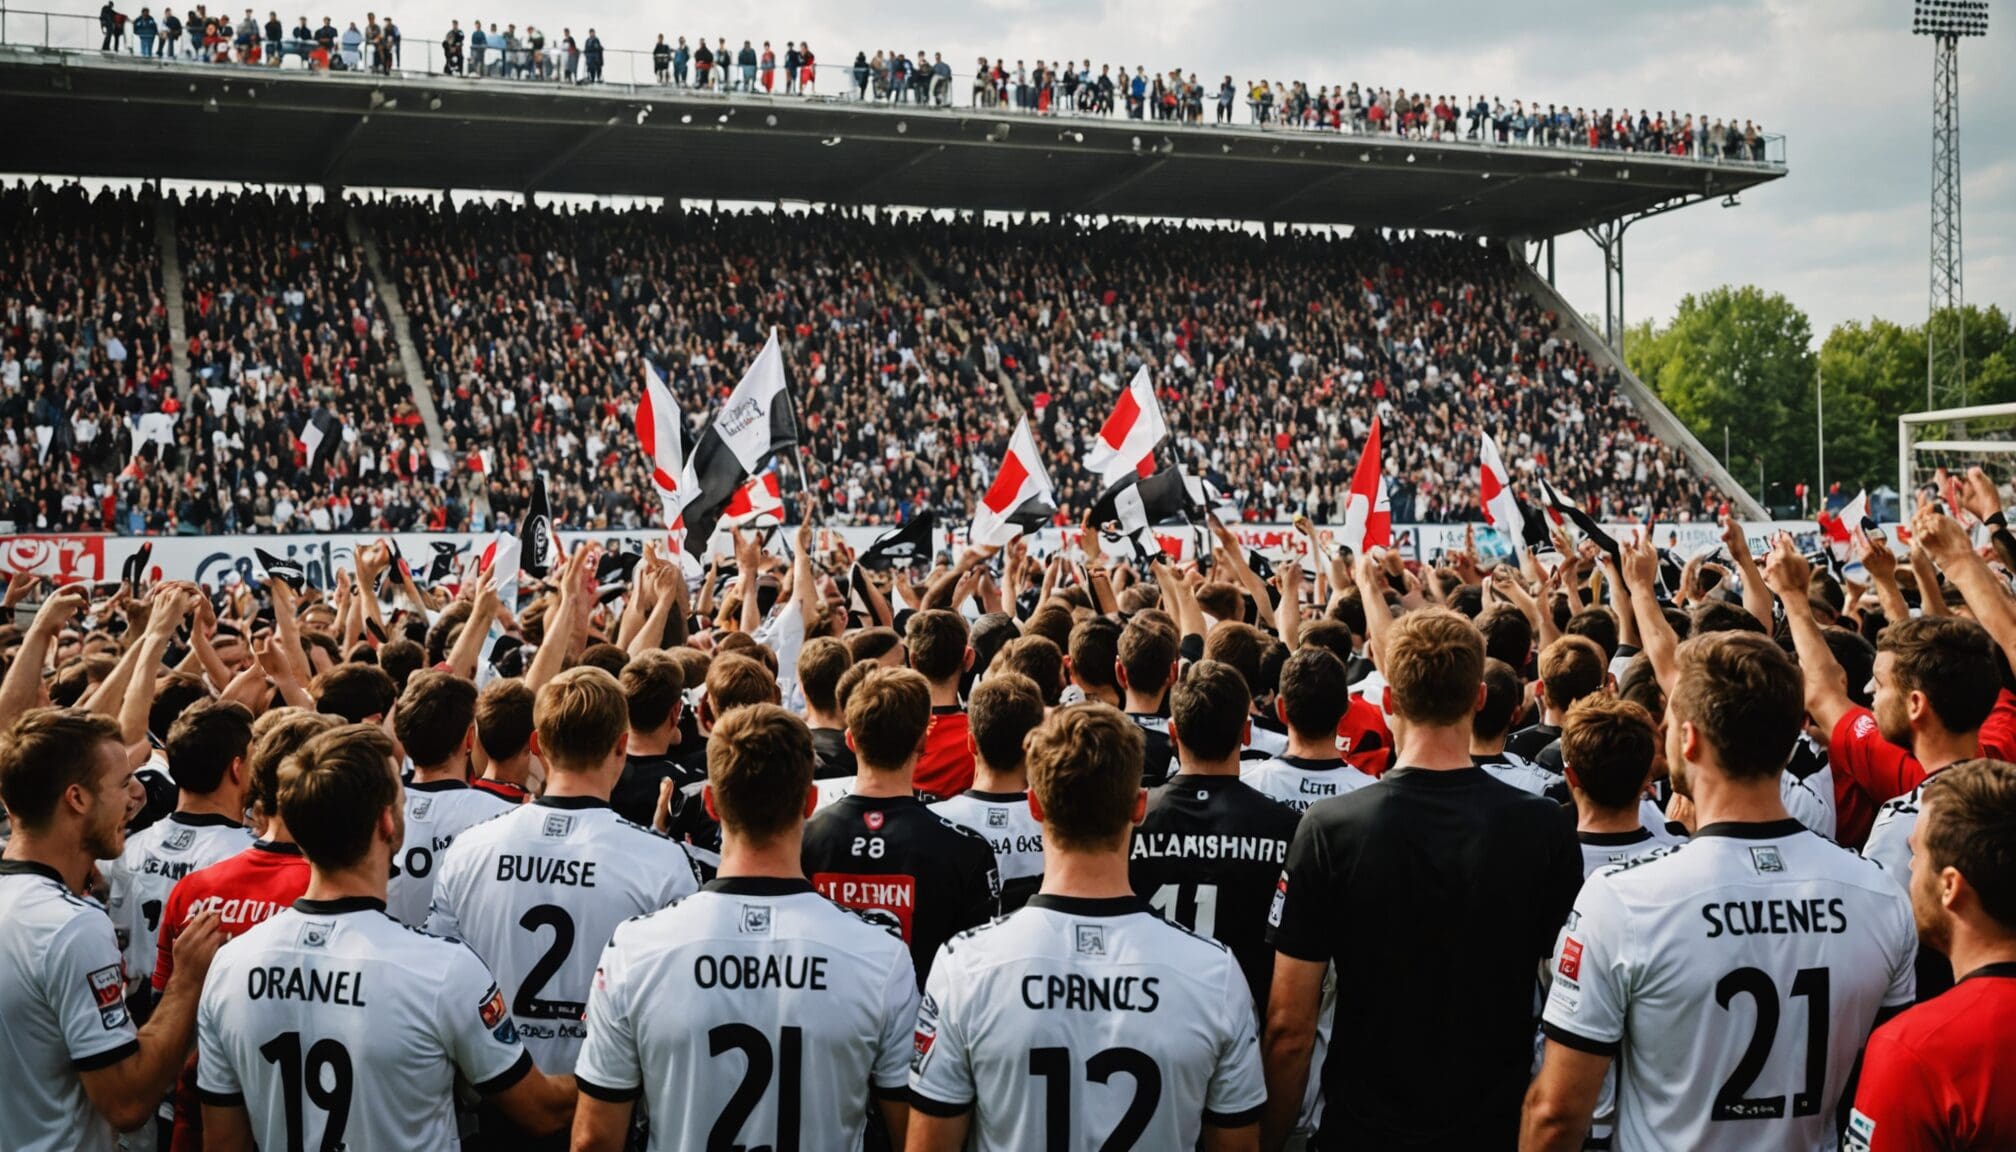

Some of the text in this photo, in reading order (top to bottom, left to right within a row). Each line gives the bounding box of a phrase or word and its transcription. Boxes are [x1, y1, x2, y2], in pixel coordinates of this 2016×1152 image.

[248, 966, 366, 1007] ORANEL
[512, 904, 588, 1021] 2
[259, 1032, 354, 1152] 19
[706, 1023, 803, 1152] 21
[1029, 1047, 1162, 1152] 12
[1711, 967, 1830, 1122] 21
